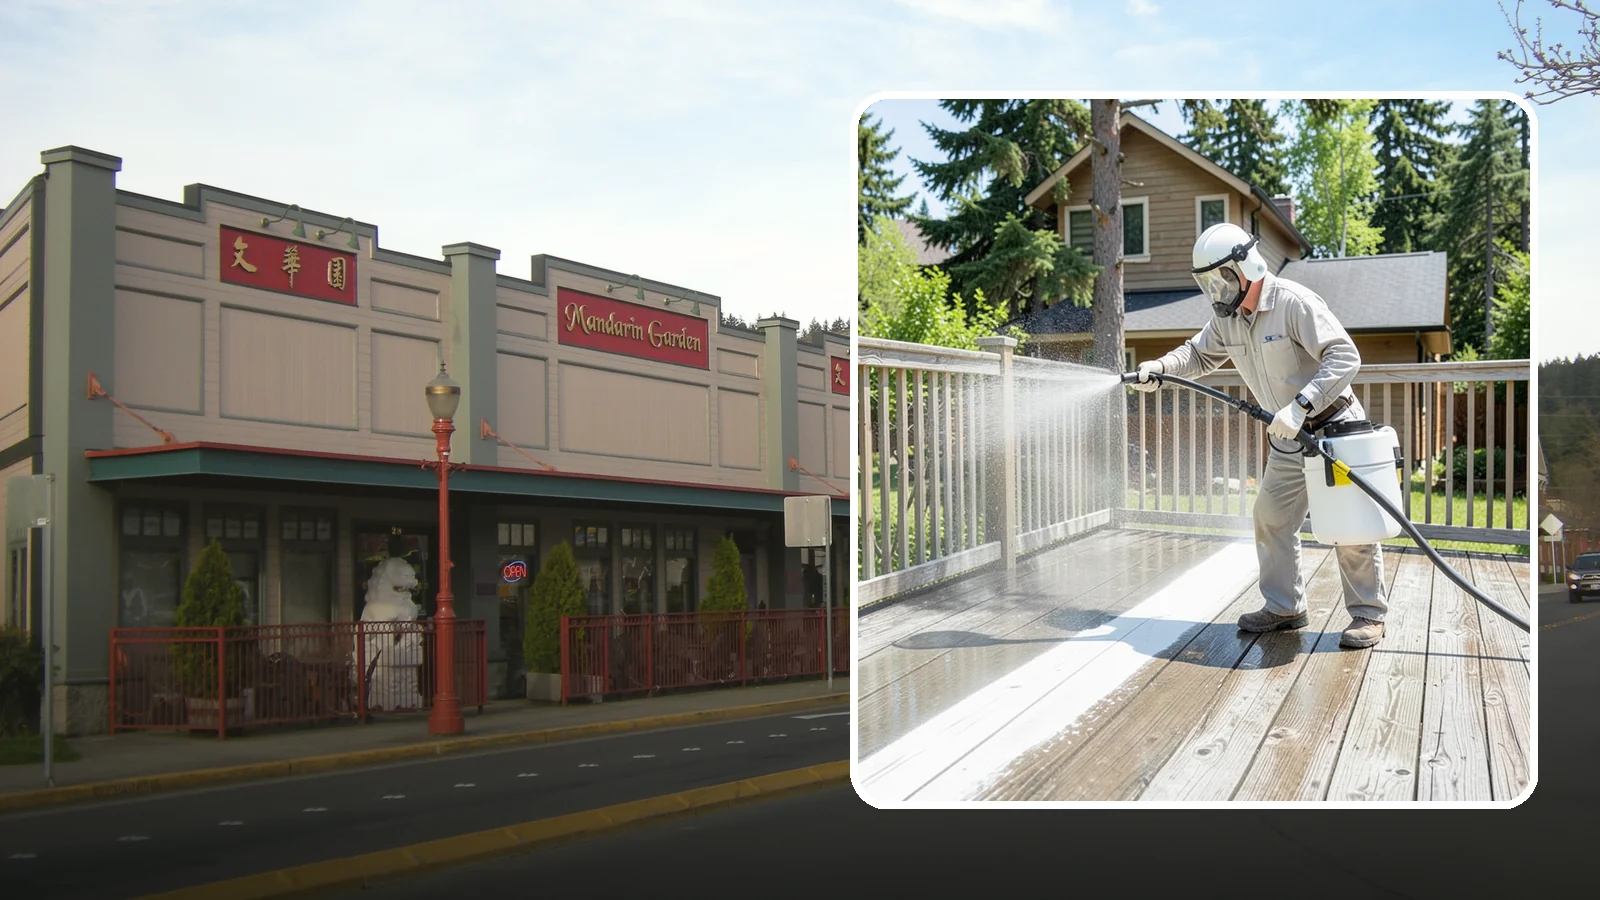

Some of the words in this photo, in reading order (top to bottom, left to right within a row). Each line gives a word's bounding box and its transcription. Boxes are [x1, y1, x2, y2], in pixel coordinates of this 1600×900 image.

[231, 236, 346, 291] 文華園
[564, 302, 644, 341] Mandarin
[648, 320, 701, 352] Garden
[503, 565, 527, 578] OPEN
